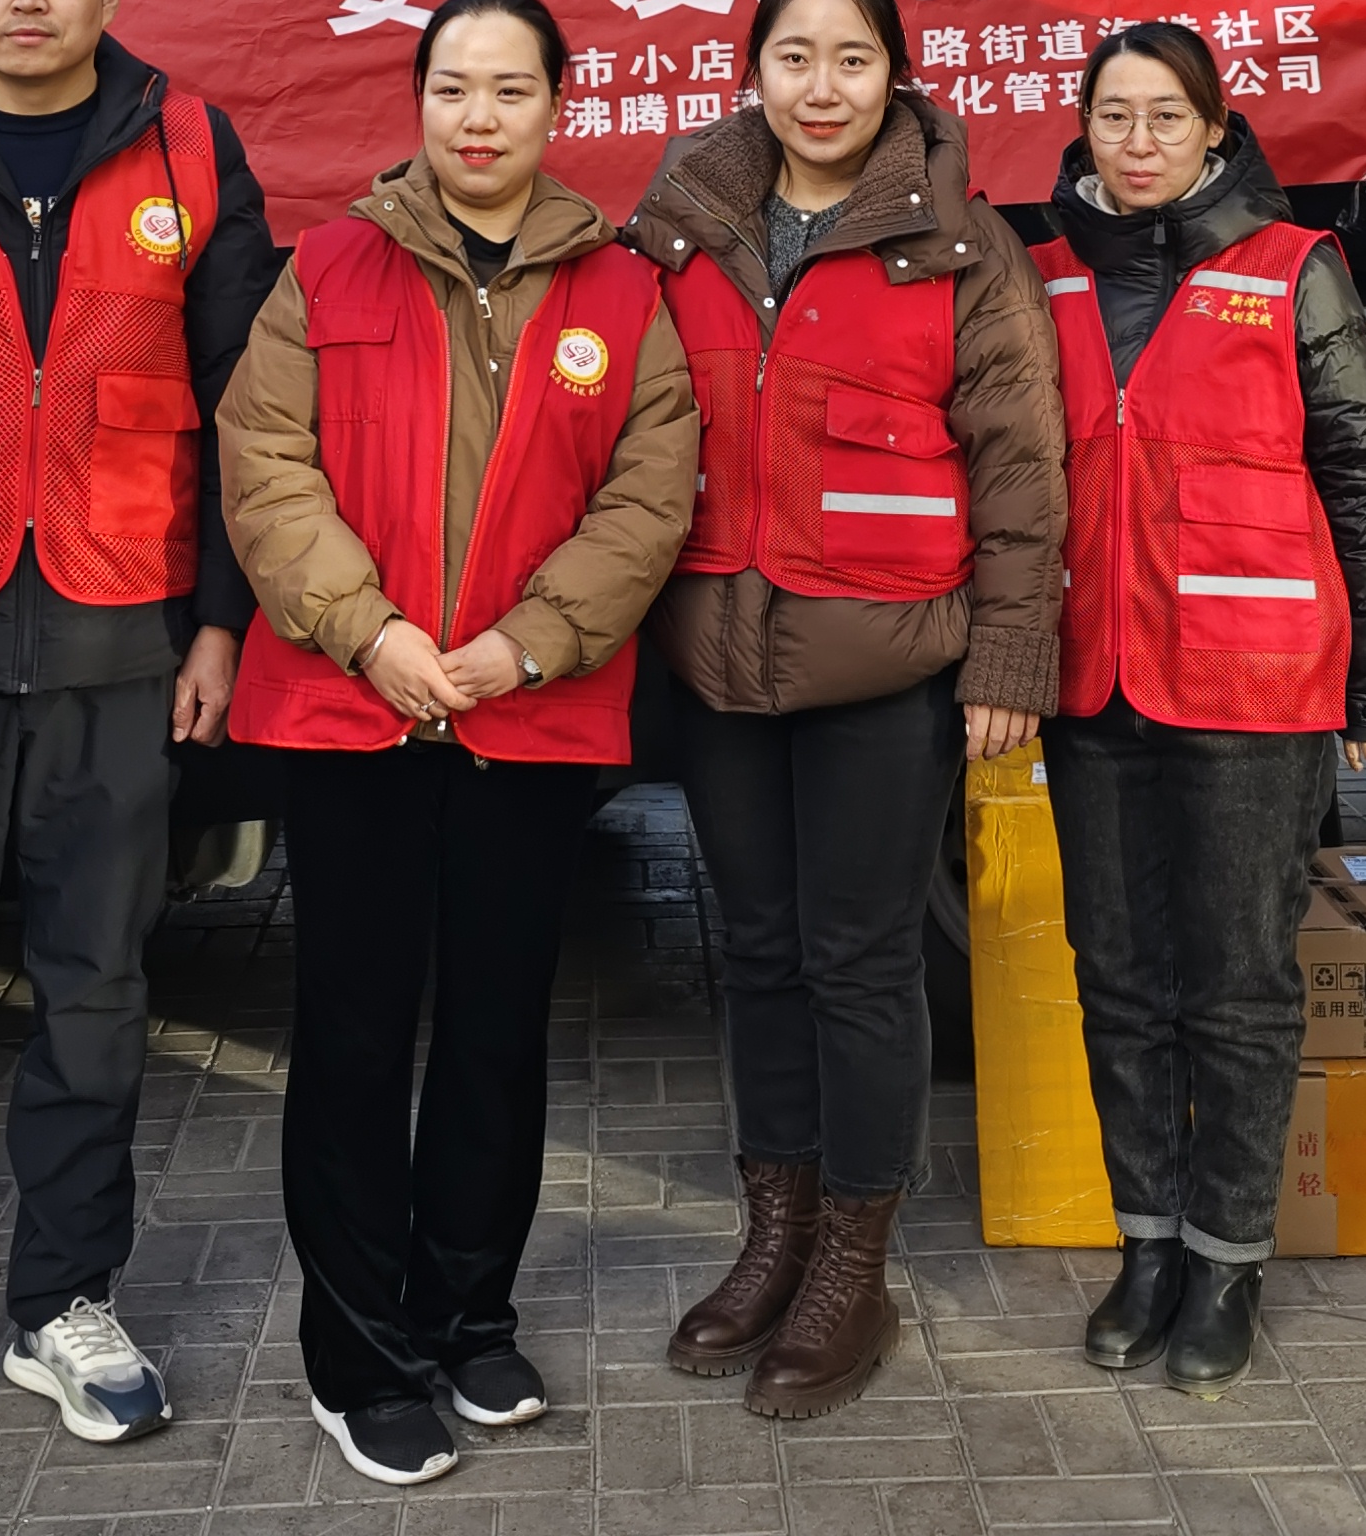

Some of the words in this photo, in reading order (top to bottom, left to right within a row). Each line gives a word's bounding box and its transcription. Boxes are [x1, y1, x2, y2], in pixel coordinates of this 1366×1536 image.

[1227, 293, 1271, 310] 新时代
[1217, 309, 1273, 330] 文明实践
